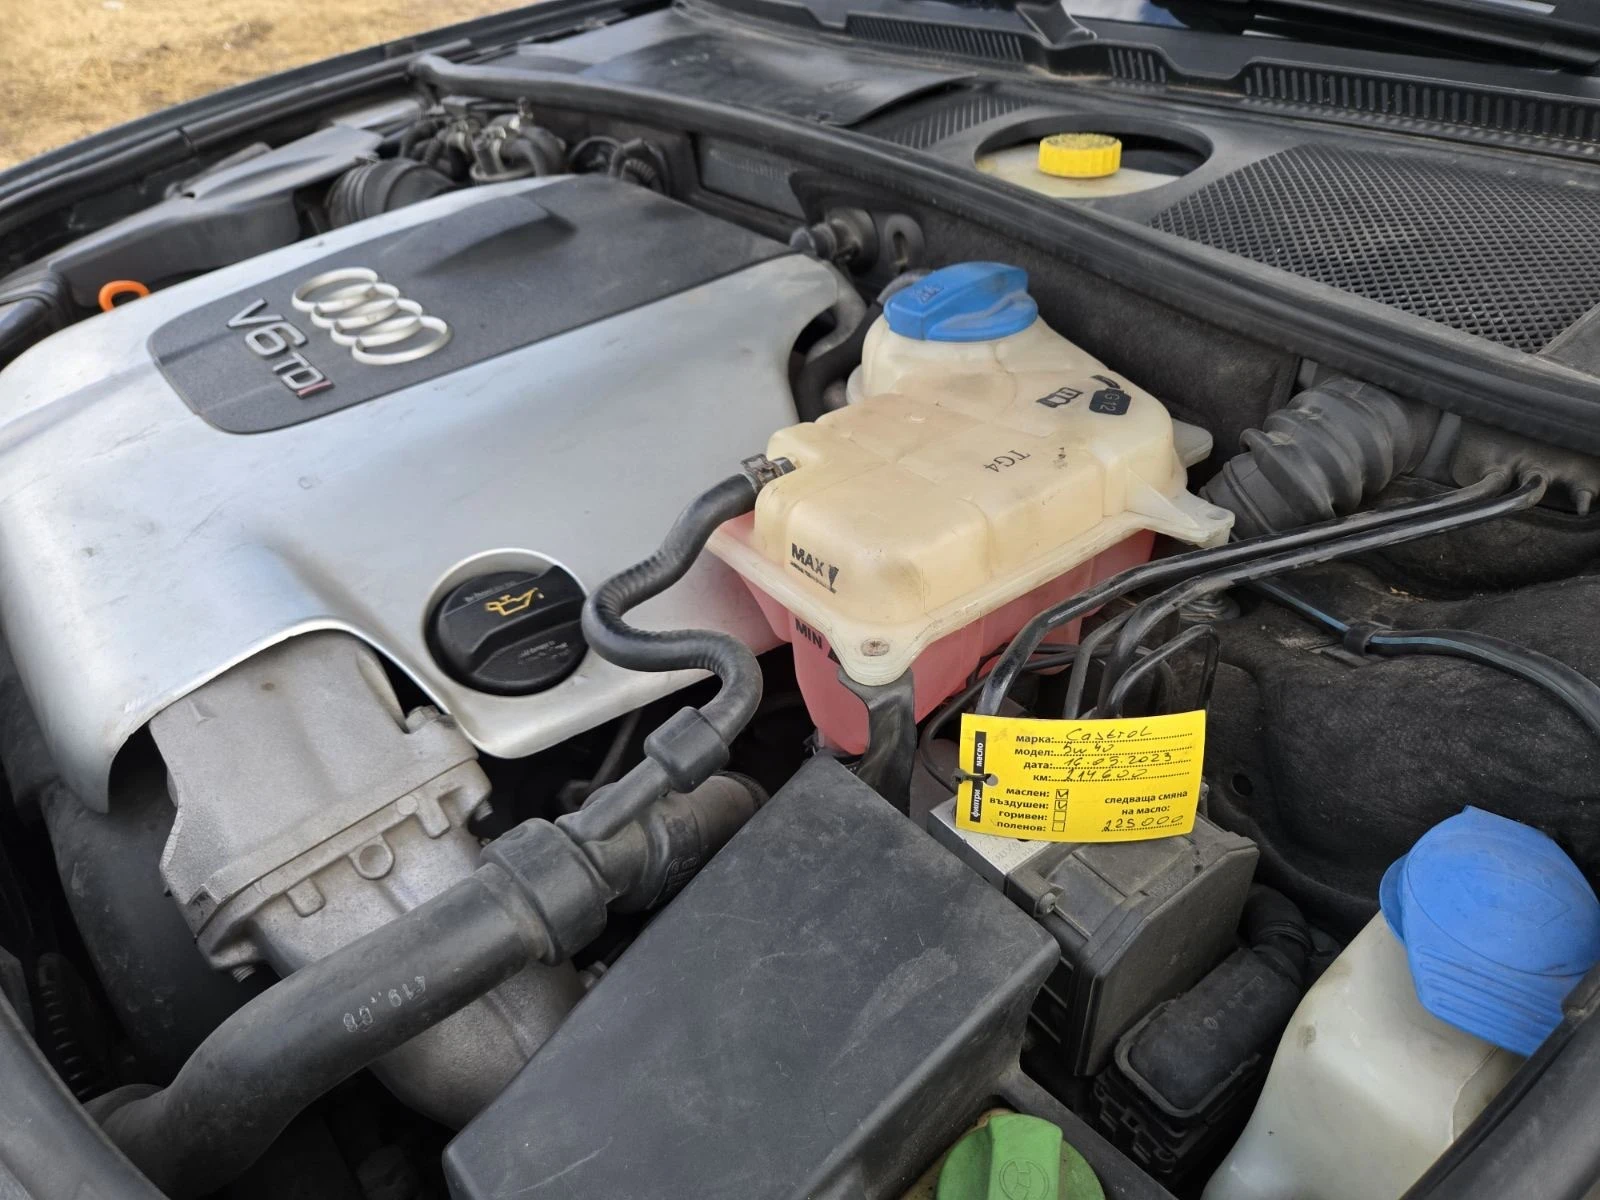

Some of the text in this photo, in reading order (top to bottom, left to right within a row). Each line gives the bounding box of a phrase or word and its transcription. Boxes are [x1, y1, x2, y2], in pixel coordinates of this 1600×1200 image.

[226, 297, 335, 400] V6 TDI
[1099, 392, 1120, 412] G12
[983, 449, 1031, 473] TG4
[791, 542, 824, 577] MAX
[795, 617, 822, 649] MIN
[1016, 734, 1054, 745] марка:
[976, 742, 984, 767] масло
[1014, 747, 1054, 758] модел:
[1023, 760, 1053, 770] дата:
[1033, 774, 1051, 782] км:
[1006, 787, 1050, 798] маслен:
[1104, 790, 1188, 805] следваща смяна
[970, 788, 981, 818] филтри
[990, 797, 1049, 810] въздушен:
[999, 809, 1048, 821] горивен:
[1136, 805, 1170, 815] масло:
[997, 820, 1047, 832] поленов:
